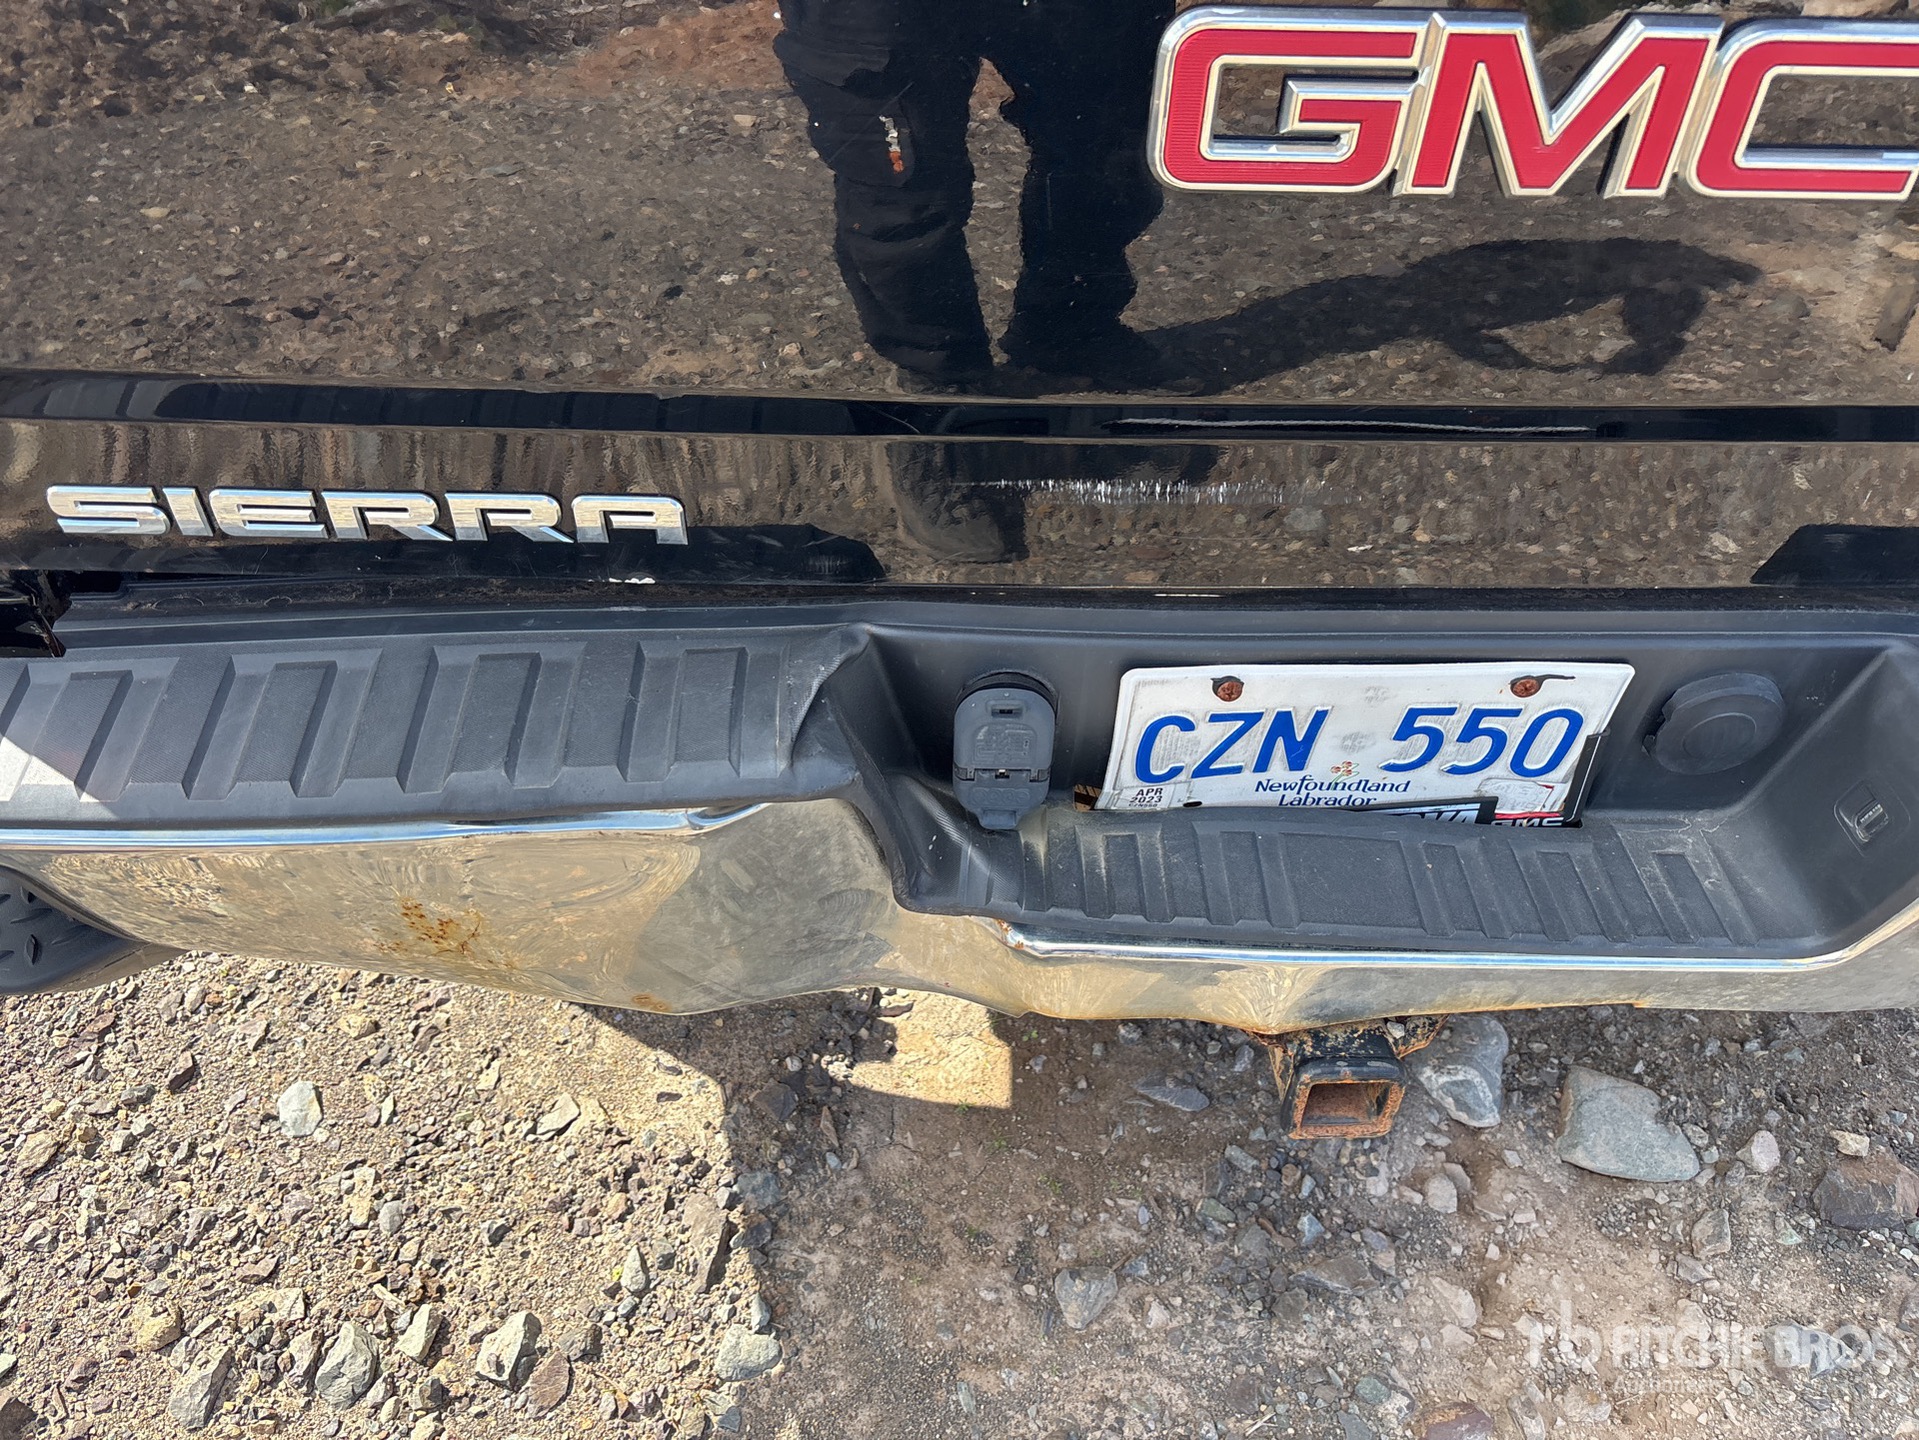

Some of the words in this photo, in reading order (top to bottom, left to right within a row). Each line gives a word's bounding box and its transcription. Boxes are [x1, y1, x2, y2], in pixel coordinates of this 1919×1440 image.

[1147, 6, 1919, 200] GMC
[46, 485, 689, 546] SIERRA
[1135, 707, 1331, 784] CZN
[1378, 706, 1585, 778] 550
[1135, 787, 1163, 797] APR
[1255, 774, 1412, 795] Newfoundland
[1129, 795, 1163, 804] 2023
[1278, 792, 1377, 806] Labrador
